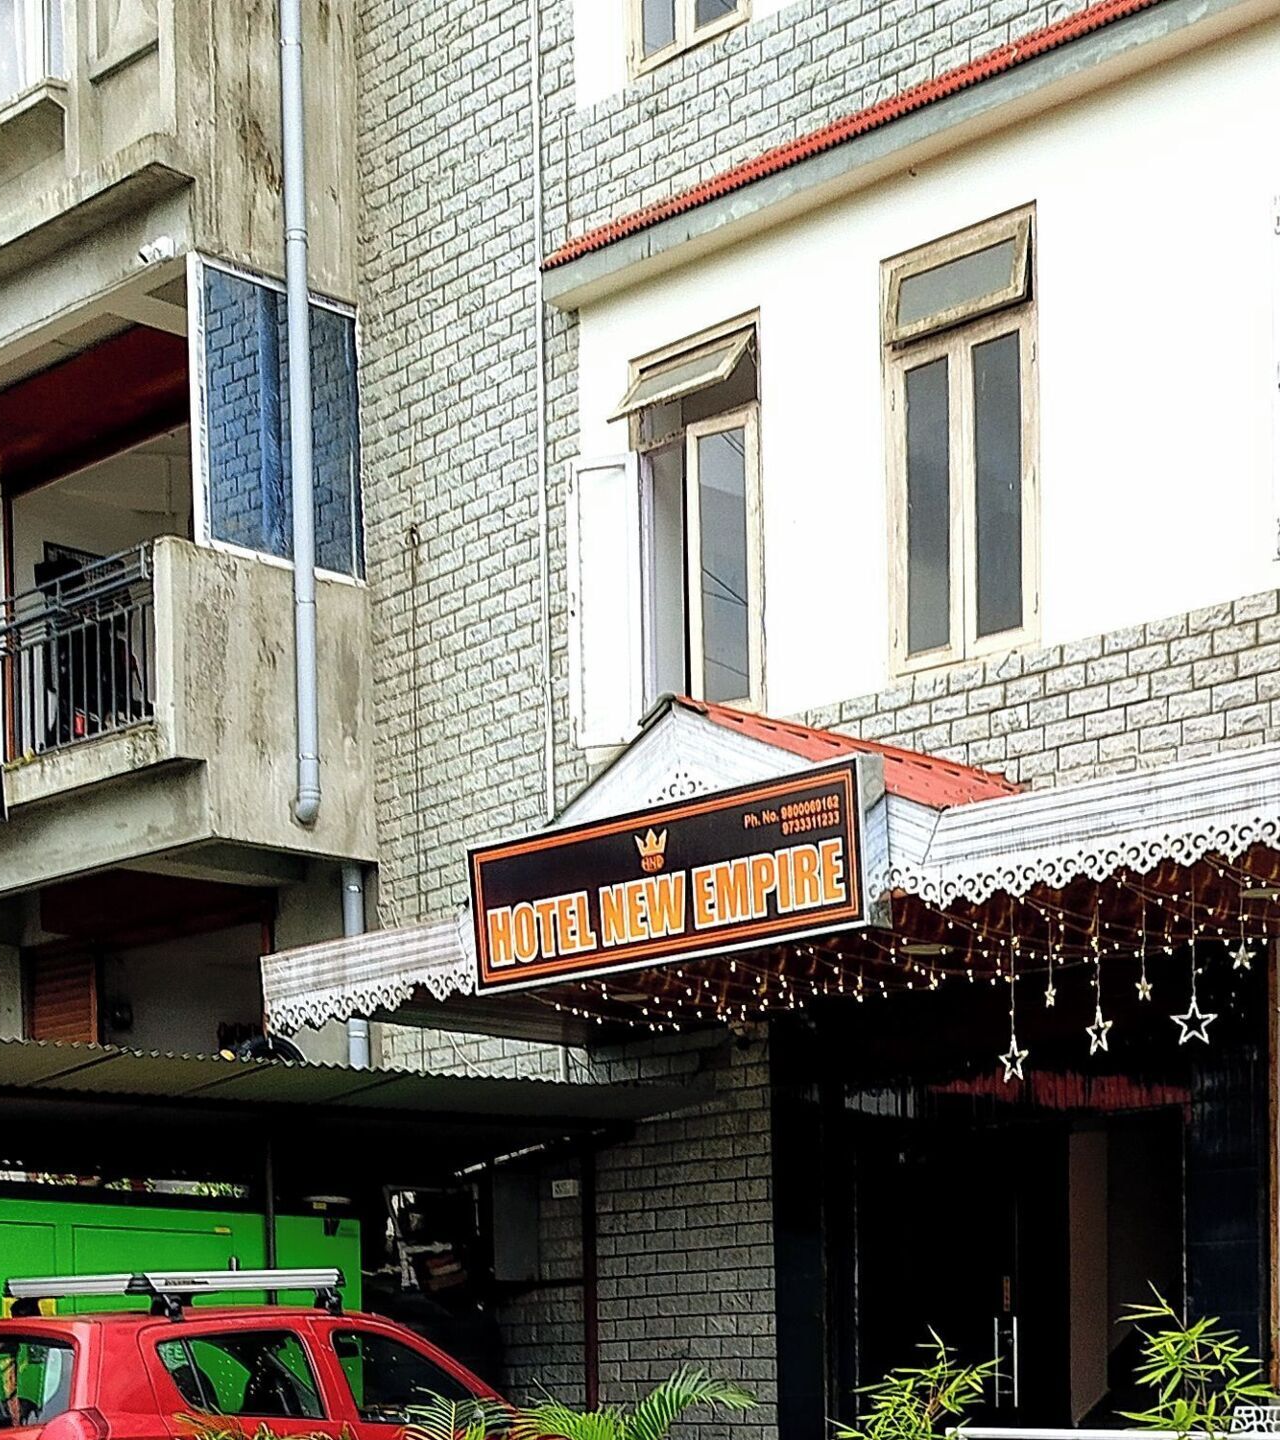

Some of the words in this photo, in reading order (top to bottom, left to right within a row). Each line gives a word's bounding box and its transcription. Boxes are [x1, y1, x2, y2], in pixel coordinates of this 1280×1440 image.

[744, 813, 760, 829] Ph.
[762, 809, 779, 825] No.
[487, 891, 597, 968] HOTEL
[598, 871, 687, 948] NEW
[691, 837, 848, 930] EMPIRE
